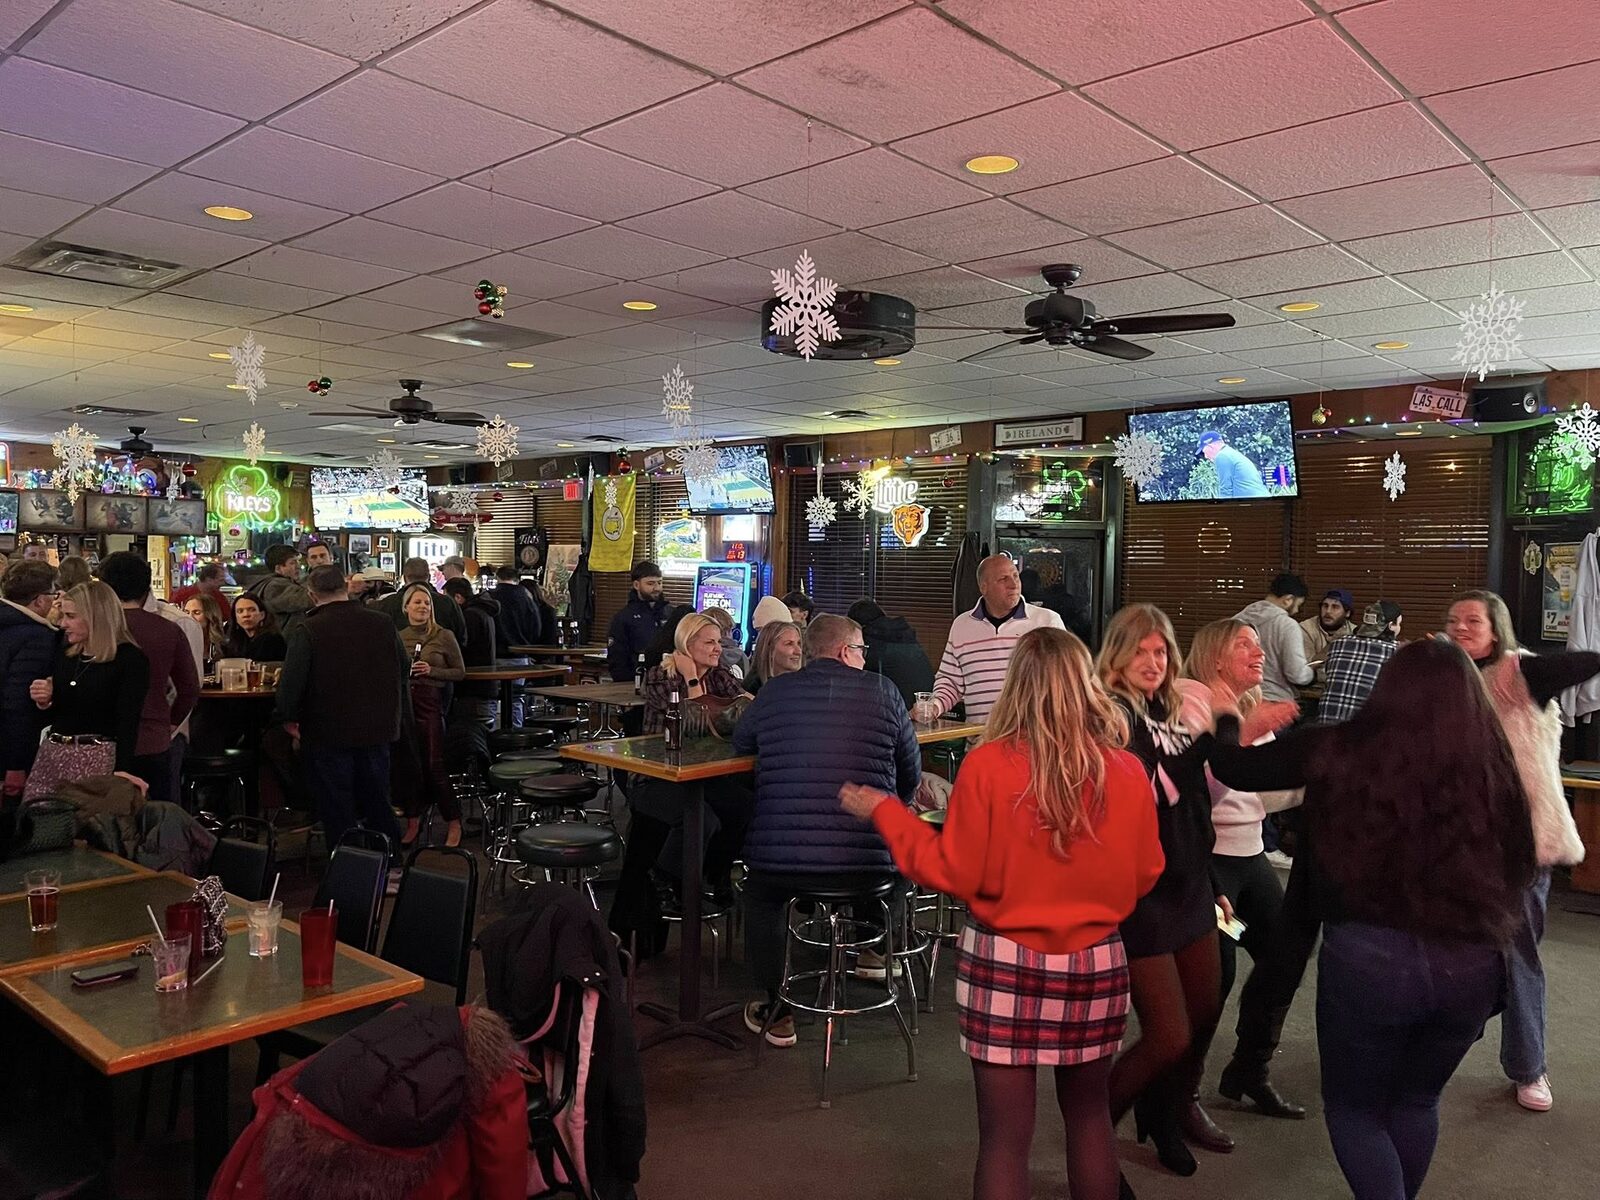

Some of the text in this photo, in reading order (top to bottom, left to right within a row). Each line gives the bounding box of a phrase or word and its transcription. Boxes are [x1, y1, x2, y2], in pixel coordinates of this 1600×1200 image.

[1412, 393, 1461, 412] LAS CALL
[1013, 426, 1062, 438] IRELAND
[519, 533, 540, 545] Tito's
[720, 600, 731, 608] ON
